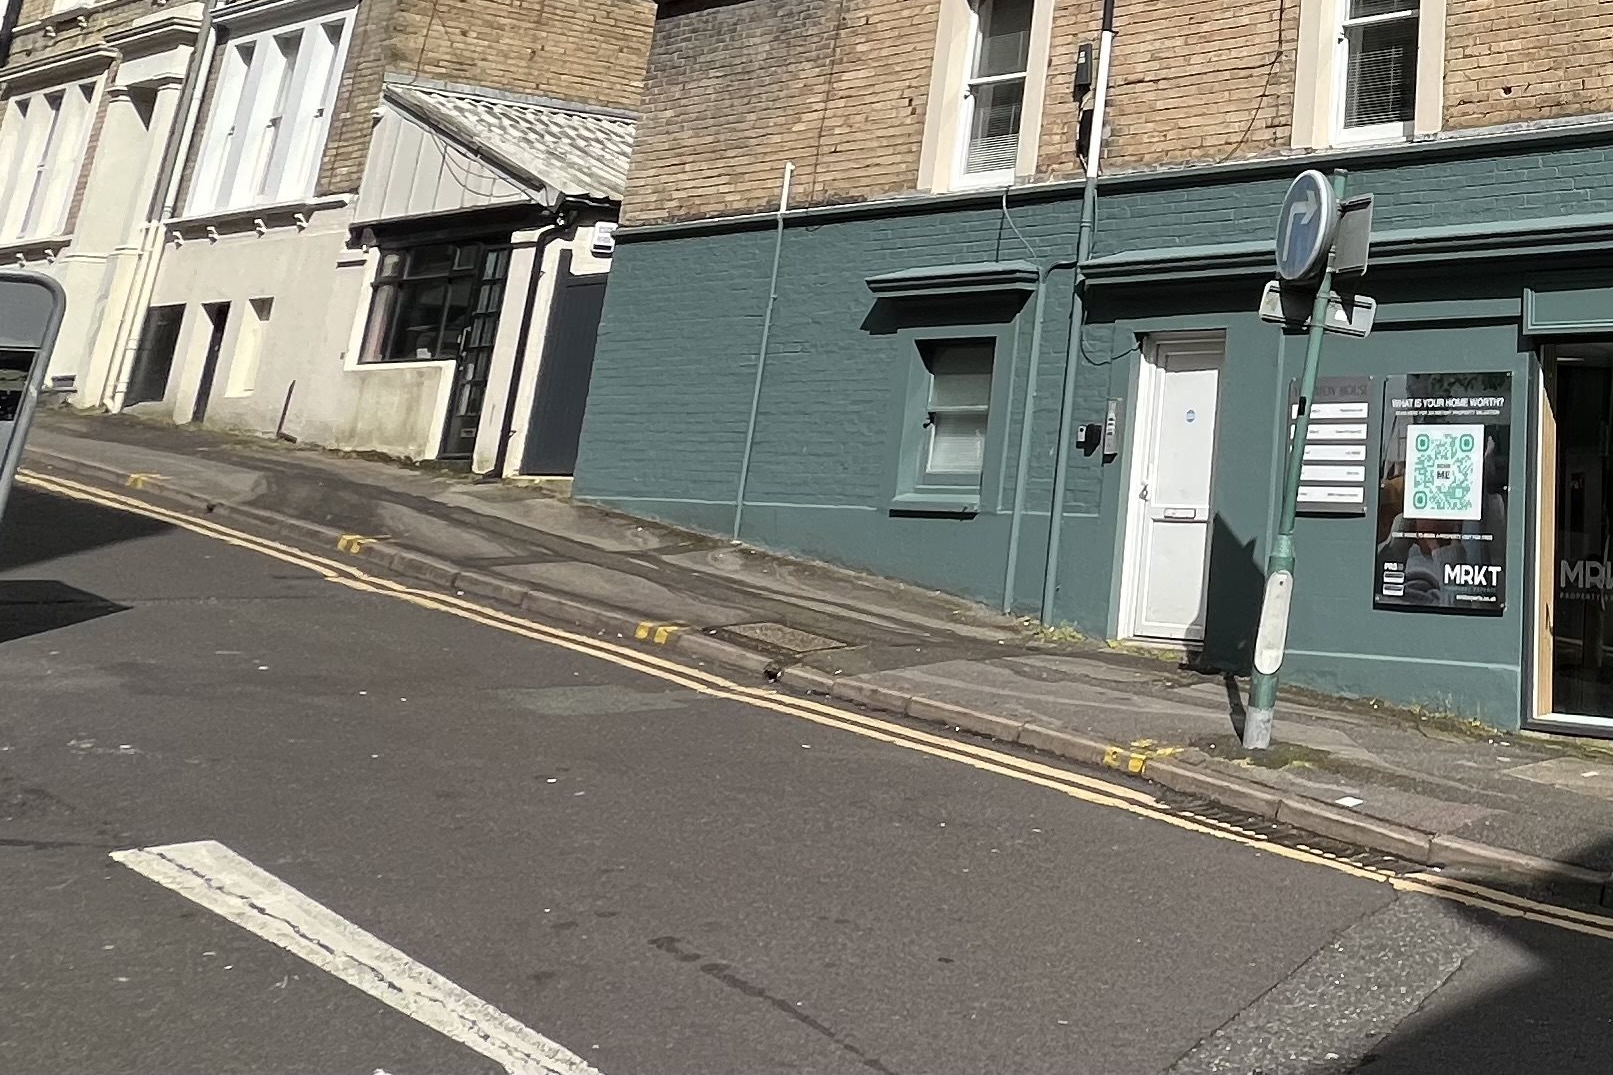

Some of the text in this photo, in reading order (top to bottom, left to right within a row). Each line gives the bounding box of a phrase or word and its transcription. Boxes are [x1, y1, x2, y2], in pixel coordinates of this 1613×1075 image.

[1414, 398, 1422, 408] IS
[1423, 398, 1445, 408] YOUR
[1446, 398, 1468, 408] HOME
[1469, 397, 1505, 407] WORTH?
[1444, 564, 1502, 586] MRKT
